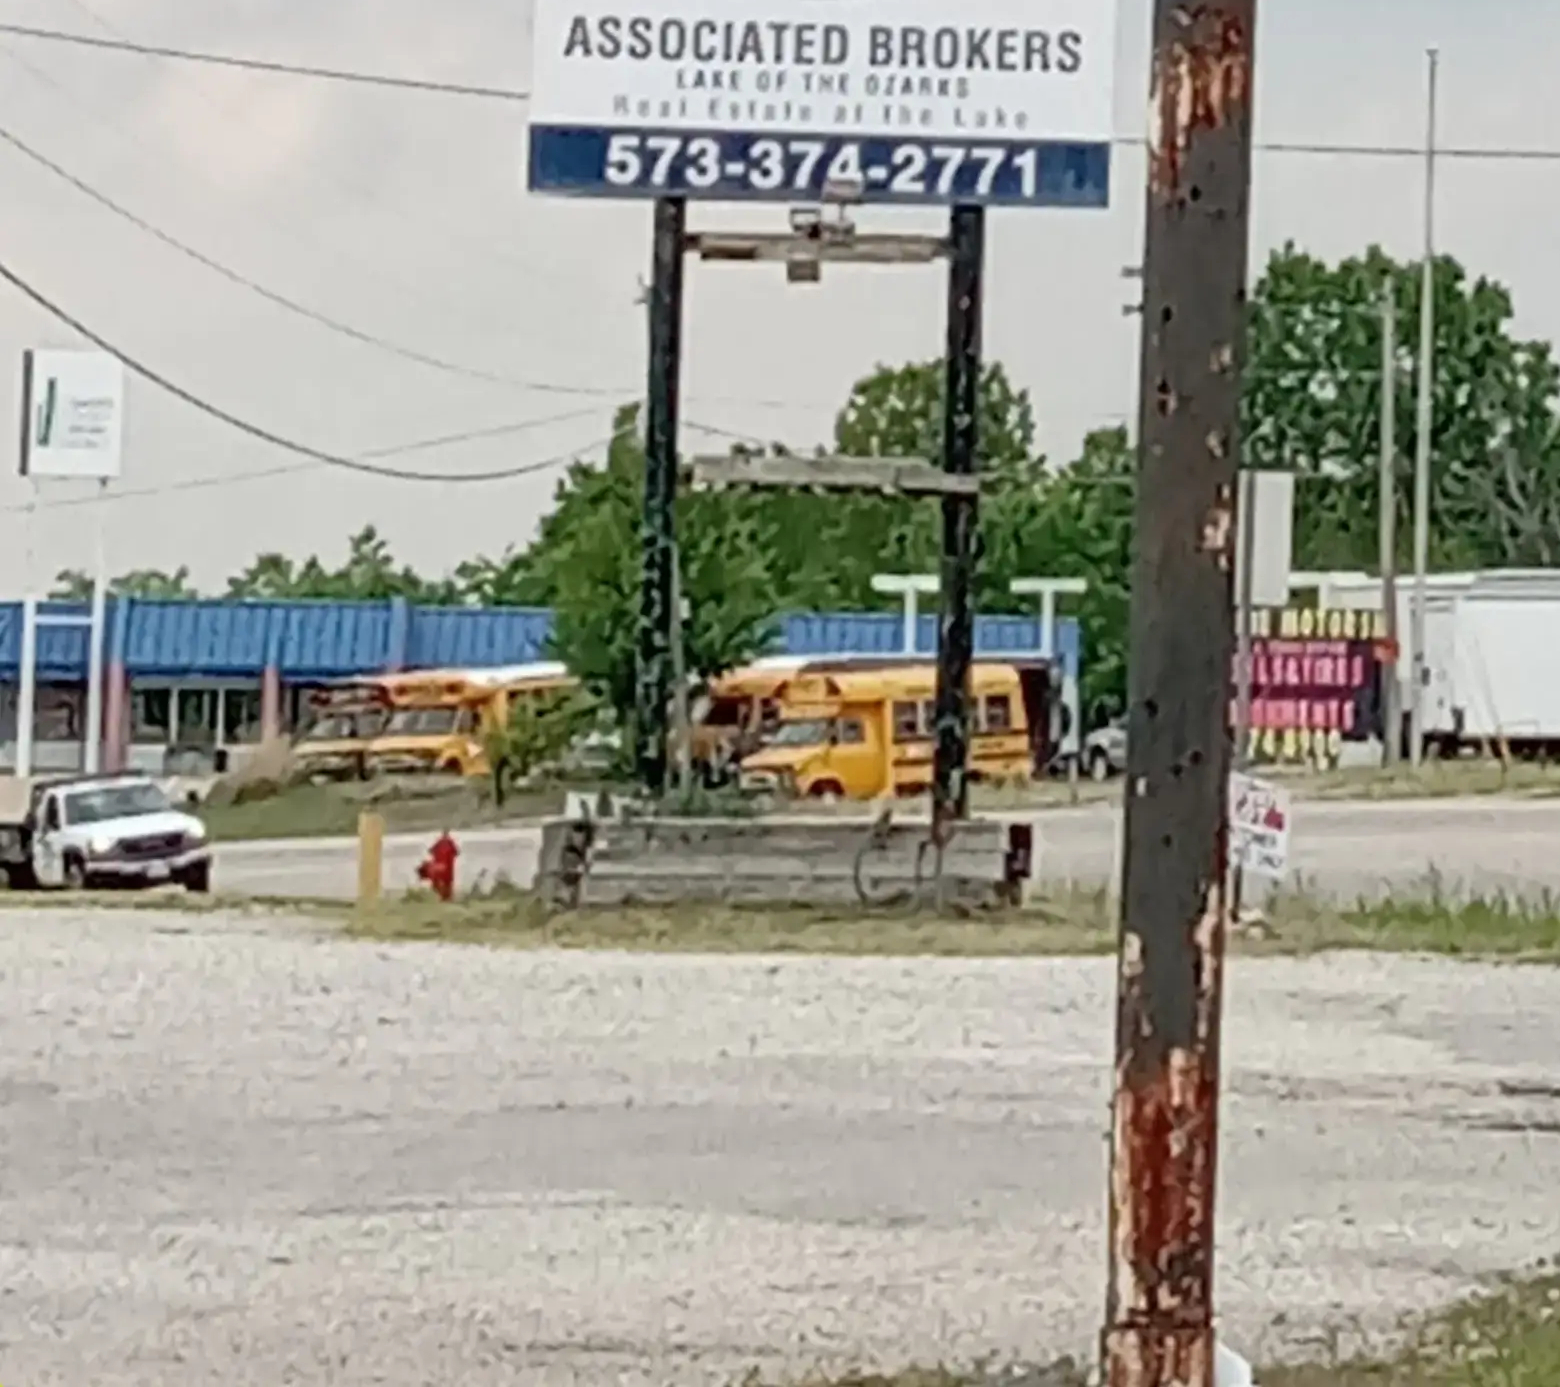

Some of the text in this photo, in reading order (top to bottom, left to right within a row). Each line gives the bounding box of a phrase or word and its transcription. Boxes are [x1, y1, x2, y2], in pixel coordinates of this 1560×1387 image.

[563, 15, 1083, 73] ASSOCIATED BROKERS
[676, 69, 971, 99] LAKE OF THE OZARKS
[604, 135, 1038, 197] 573-374-2771
